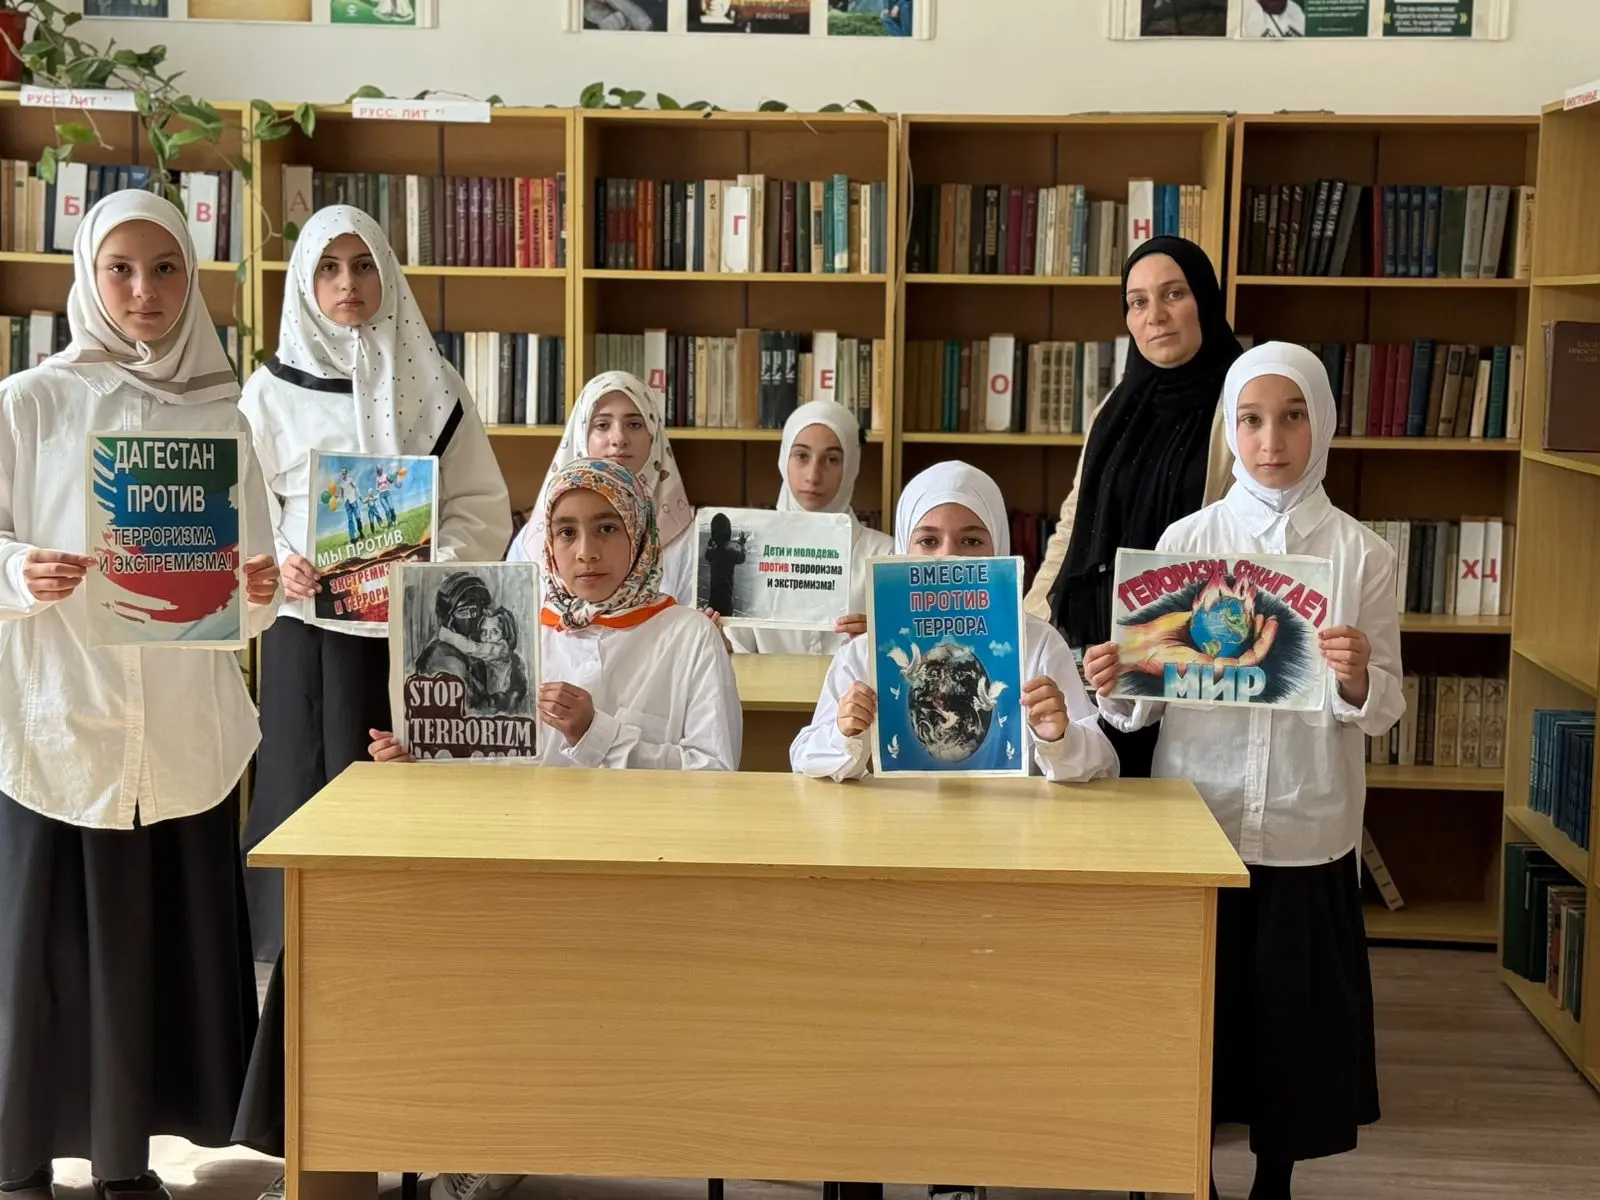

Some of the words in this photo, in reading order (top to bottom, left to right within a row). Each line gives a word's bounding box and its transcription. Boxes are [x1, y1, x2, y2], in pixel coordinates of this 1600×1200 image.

[359, 106, 398, 118] РУСС.
[402, 108, 429, 120] ЛИТ
[63, 195, 81, 216] Б
[289, 189, 310, 212] А
[195, 201, 212, 223] В
[732, 215, 747, 236] Г
[1133, 218, 1151, 240] Н
[648, 368, 665, 393] Д
[820, 369, 834, 389] Е
[990, 373, 1010, 394] О
[114, 440, 216, 474] ДАГЕСТАН
[127, 484, 206, 513] ПРОТИВ
[111, 527, 217, 546] ТЕРРОРИЗМА
[317, 548, 343, 568] МЫ
[346, 529, 404, 559] ПРОТИВ
[763, 544, 785, 559] Дети
[786, 547, 793, 556] и
[793, 547, 840, 560] молодежь
[99, 555, 110, 573] И
[113, 551, 233, 573] ЭКСТРЕМИЗМА!
[758, 562, 789, 573] против
[791, 563, 843, 576] терроризма
[767, 579, 773, 588] и
[774, 578, 836, 591] экстремизма!
[909, 564, 989, 585] ВМЕСТЕ
[334, 600, 344, 616] И
[910, 590, 990, 612] ПРОТИВ
[914, 616, 988, 637] ТЕРРОРА
[1163, 662, 1268, 703] МИР
[408, 680, 464, 707] STOP
[409, 718, 532, 747] TERRORIZM
